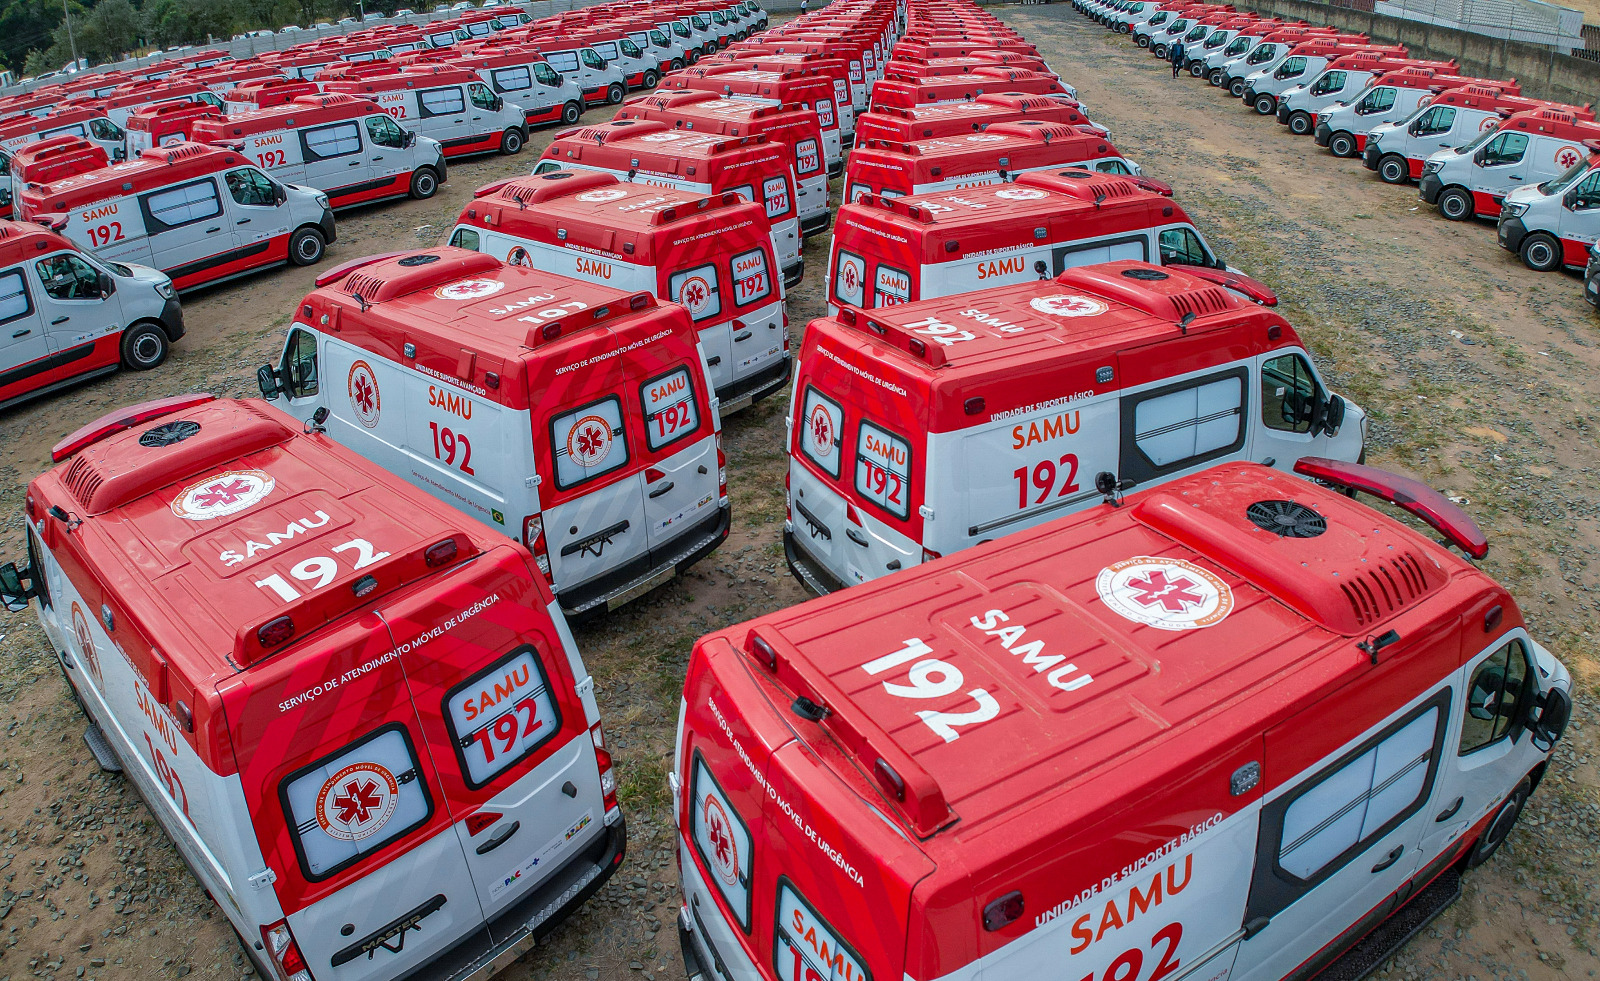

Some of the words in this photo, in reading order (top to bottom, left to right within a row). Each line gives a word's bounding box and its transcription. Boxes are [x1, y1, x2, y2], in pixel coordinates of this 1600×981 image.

[382, 94, 404, 103] SAMU
[836, 90, 845, 99] 192
[820, 112, 831, 123] 192
[8, 137, 28, 147] SAMU
[254, 134, 283, 147] SAMU
[800, 143, 814, 152] SAMU
[257, 150, 286, 168] 192
[800, 155, 815, 169] 192
[767, 182, 784, 193] SAMU
[82, 204, 118, 222] SAMU
[768, 194, 786, 211] 192
[87, 222, 125, 247] 192
[576, 257, 611, 279] SAMU
[736, 256, 761, 273] SAMU
[978, 256, 1025, 280] SAMU
[738, 273, 764, 298] 192
[881, 274, 907, 290] SAMU
[489, 292, 555, 315] SAMU
[902, 317, 976, 346] 192
[959, 309, 1025, 333] SAMU
[555, 363, 580, 375] SERVIÇO
[589, 346, 627, 364] ATENDIMENTO
[628, 341, 644, 351] MÓVEL
[651, 328, 673, 342] URGÊNCIA
[415, 363, 433, 376] UNIDADE
[440, 372, 459, 386] SUPORTE
[460, 380, 486, 396] AVANÇADO
[651, 376, 686, 403] SAMU
[860, 370, 875, 383] MÓVEL
[875, 377, 882, 386] DE
[882, 380, 907, 397] URGÊNCIA
[428, 385, 473, 421] SAMU
[990, 406, 1024, 422] UNIDADE
[1025, 404, 1035, 413] DE
[1036, 396, 1068, 410] SUPORTE
[1068, 390, 1094, 402] BÁSICO
[653, 401, 692, 438] 192
[1012, 410, 1081, 450] SAMU
[429, 421, 475, 476] 192
[865, 434, 905, 466] SAMU
[863, 461, 901, 506] 192
[1014, 453, 1080, 510] 192
[220, 510, 330, 566] SAMU
[255, 538, 391, 603] 192
[1114, 559, 1142, 570] SERVIÇO
[1159, 560, 1214, 581] ATENDIMENTO
[278, 686, 322, 712] SERVIÇO
[324, 678, 338, 691] DE
[341, 644, 410, 684] ATENDIMENTO
[412, 626, 444, 648] MÓVEL
[444, 618, 457, 631] DE
[456, 594, 500, 623] URGÊNCIA
[970, 609, 1094, 692] SAMU
[463, 663, 530, 722] SAMU
[860, 637, 1001, 744] 192
[134, 680, 177, 756] SAMU
[472, 697, 543, 764] 192
[708, 697, 727, 730] SERVIÇO
[726, 727, 734, 743] DE
[733, 739, 777, 799] ATENDIMENTO
[777, 796, 804, 830] MÓVEL
[805, 825, 816, 842] DE
[817, 838, 864, 888] URGÊNCIA
[504, 870, 521, 886] PAC
[1034, 884, 1098, 928] UNIDADE
[1100, 872, 1118, 892] DE
[1121, 838, 1178, 878] SUPORTE
[1180, 812, 1222, 844] BÁSICO
[1070, 853, 1193, 956] SAMU
[362, 915, 421, 951] MASTER
